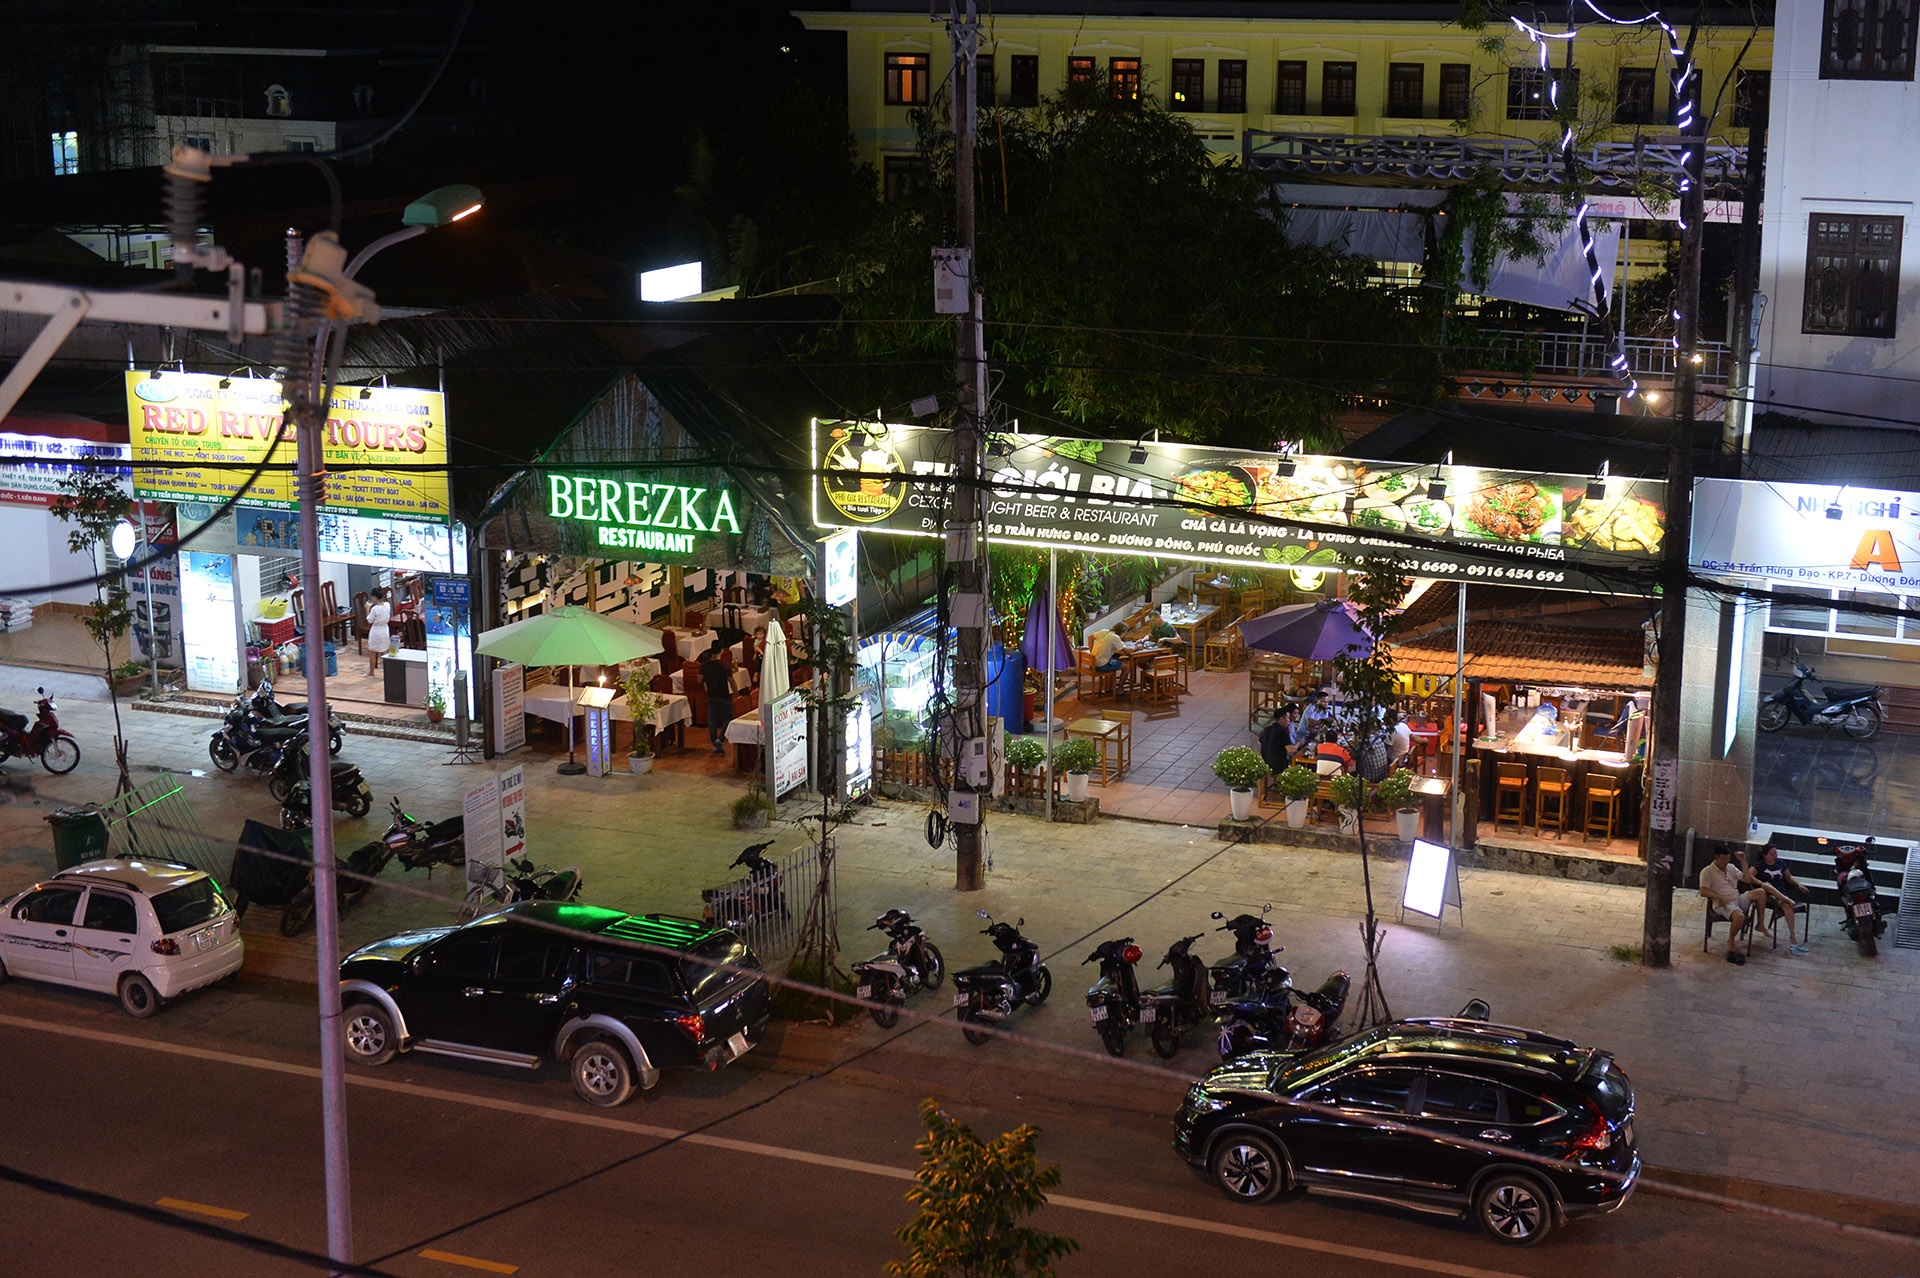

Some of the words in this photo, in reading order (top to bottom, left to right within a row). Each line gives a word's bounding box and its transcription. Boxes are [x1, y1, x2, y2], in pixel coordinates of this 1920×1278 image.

[142, 404, 207, 435] RED
[219, 410, 298, 443] RIVE
[325, 418, 427, 453] TOURS
[202, 441, 222, 450] TOURS
[212, 453, 226, 461] SQUID
[227, 454, 245, 462] FISHING
[186, 471, 201, 479] DIVING
[357, 475, 374, 483] TICKET
[399, 479, 412, 487] LAND
[211, 483, 226, 491] TOURS
[258, 487, 275, 496] ISLAND
[352, 485, 368, 494] TICKET
[370, 486, 386, 495] FERRY
[1088, 474, 1155, 509] BIA
[374, 497, 391, 505] TICKET
[547, 474, 743, 534] BEREZKA
[1797, 496, 1829, 513] NH
[1025, 505, 1058, 519] BEER
[1060, 508, 1071, 520] &
[1073, 507, 1160, 527] RESTAURANT
[1180, 517, 1207, 532] CHẢ
[1209, 519, 1227, 533] CÁ
[1249, 524, 1288, 539] VỌNG
[598, 526, 696, 553] RESTAURANT
[1005, 522, 1036, 538] TRẦN
[1036, 526, 1071, 540] HƯNG
[1073, 531, 1100, 544] ĐẠO
[1197, 537, 1223, 553] PHÚ
[1225, 541, 1262, 557] QUỐC
[1526, 546, 1565, 562] РЫБА
[1849, 529, 1903, 573] A
[1420, 560, 1456, 574] 6699
[1466, 564, 1505, 578] 0916
[1505, 567, 1534, 581] 454
[1535, 570, 1565, 583] 696
[1723, 562, 1736, 571] 74
[1738, 561, 1763, 573] Trần
[1798, 568, 1820, 580] Đạo
[589, 711, 599, 771] BEREZKA
